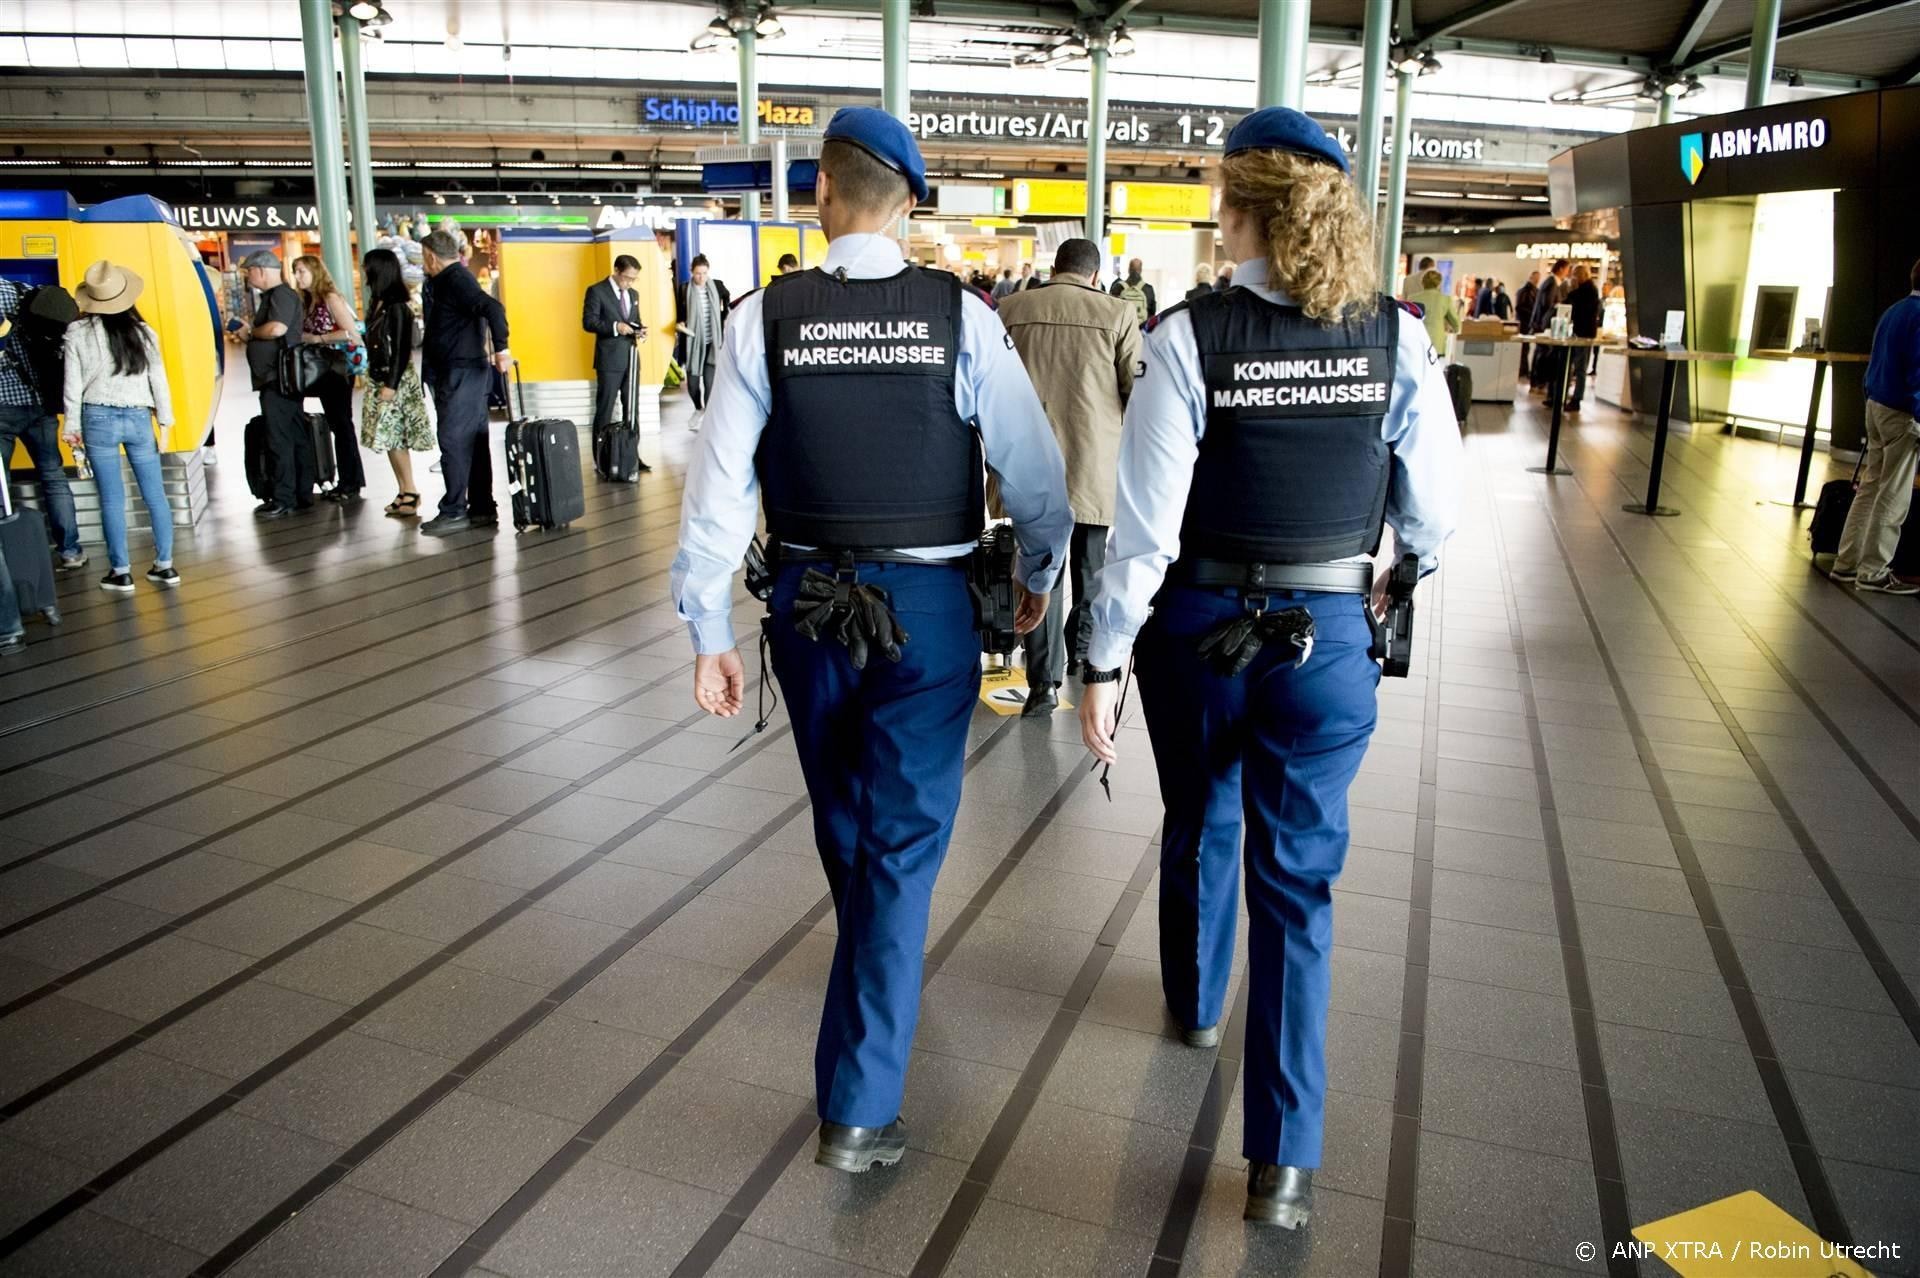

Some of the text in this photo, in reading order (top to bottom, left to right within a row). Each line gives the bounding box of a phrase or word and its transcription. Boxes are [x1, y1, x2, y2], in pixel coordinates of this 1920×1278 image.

[646, 98, 740, 128] Schipho
[908, 111, 1150, 141] epartures/Arrvals
[1177, 115, 1225, 145] 1-2
[266, 206, 287, 227] &
[800, 321, 930, 341] KONINKLIJKE
[784, 346, 945, 366] MARECHAUSSEE
[1233, 357, 1369, 381] KONINKLIJKE
[1213, 383, 1386, 407] MARECHAUSSEE
